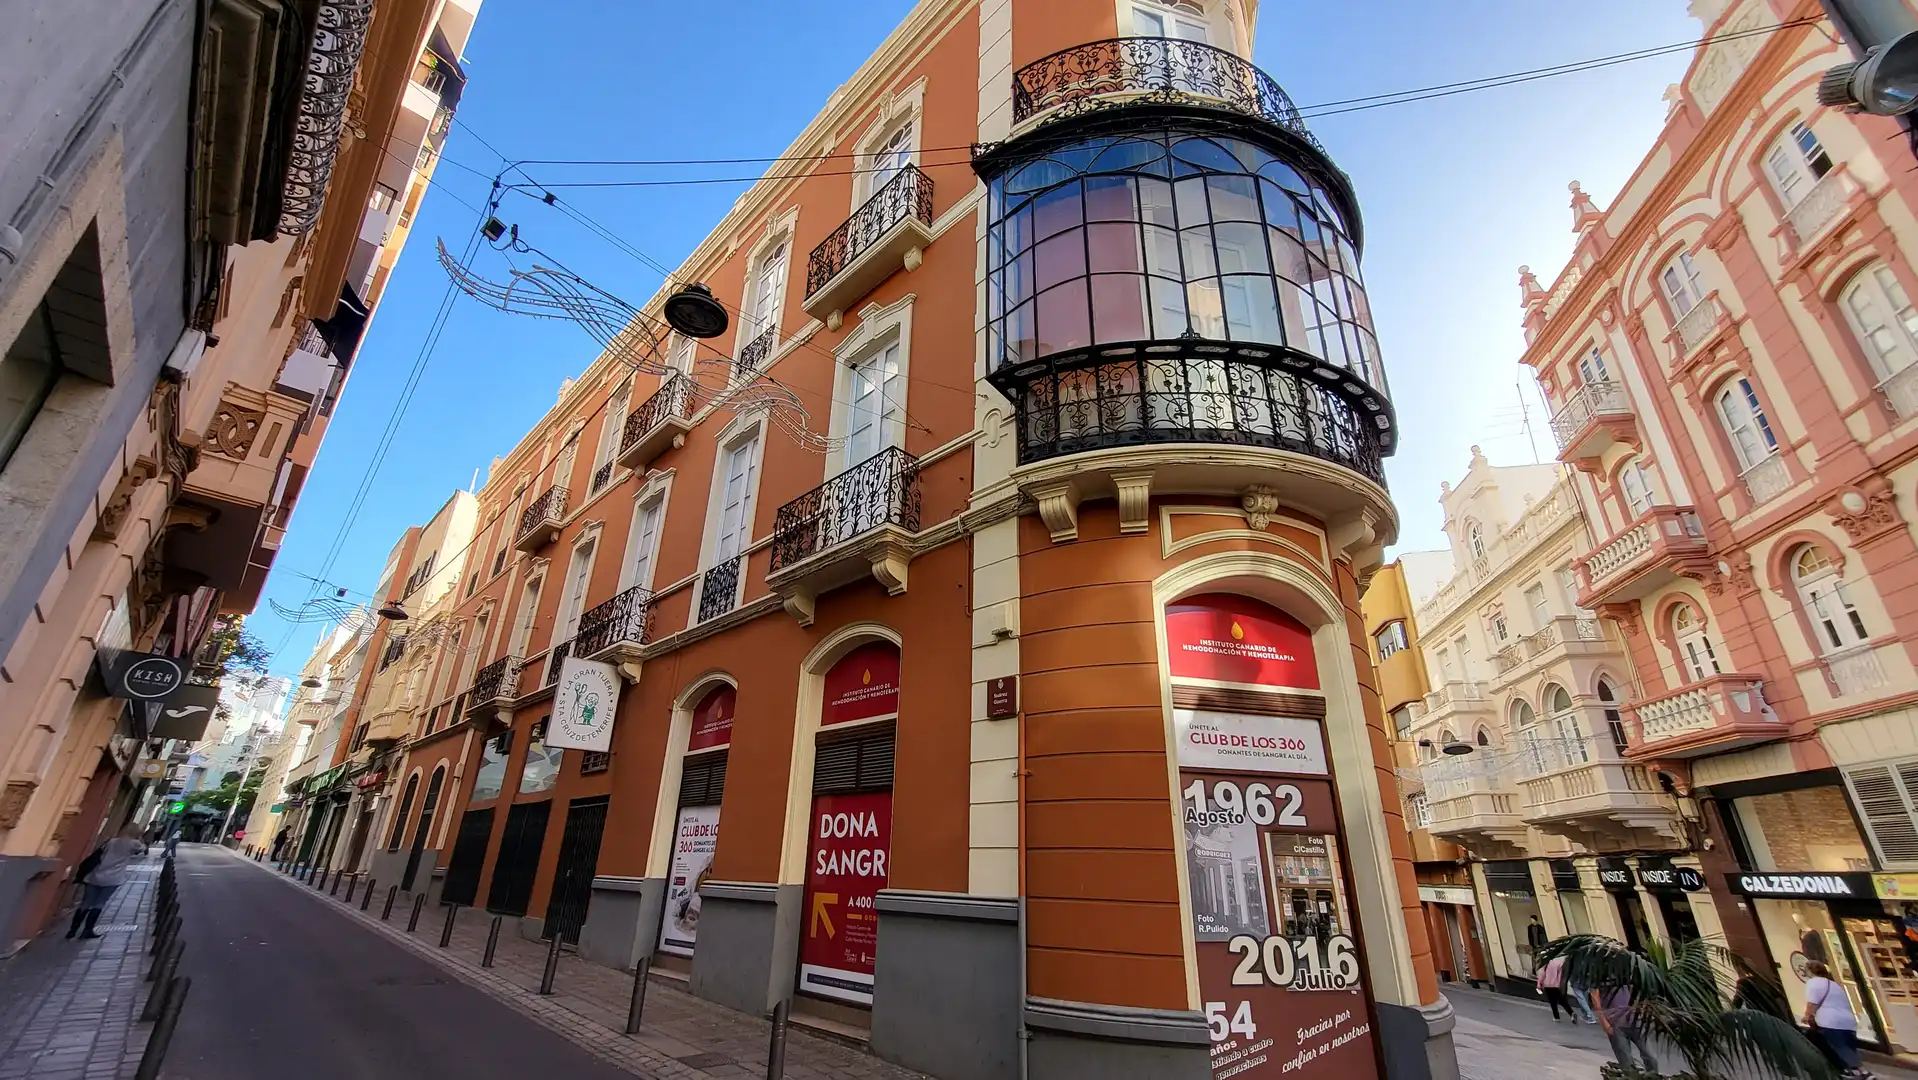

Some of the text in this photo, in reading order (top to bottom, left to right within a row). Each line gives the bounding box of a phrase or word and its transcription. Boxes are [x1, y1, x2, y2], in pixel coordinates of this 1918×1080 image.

[1182, 643, 1241, 656] HEMODONACIÓN
[1247, 651, 1295, 662] HEMOTERAPIA
[1199, 639, 1235, 649] INSTITUTO
[1235, 643, 1267, 652] CANARIO
[134, 669, 173, 683] KISH
[564, 669, 614, 697] LA GRAN TIJERA
[560, 719, 577, 739] CRUZ
[587, 707, 614, 740] TENERIFE
[1189, 722, 1210, 731] ÚNETE
[1190, 732, 1306, 751] CLUB DE LOS 300
[1217, 749, 1252, 757] DONANTES
[1261, 751, 1287, 759] SANGRE
[1183, 779, 1307, 827] 1962
[820, 811, 879, 839] DONA
[1185, 807, 1245, 827] Agosto
[681, 825, 700, 838] CLUB
[700, 824, 710, 837] DE
[678, 841, 692, 853] 300
[1308, 837, 1323, 845] Foto
[1293, 845, 1324, 854] C/Castillo
[816, 849, 886, 877] SANGR
[1600, 870, 1628, 883] INSIDE
[1641, 870, 1673, 883] INSIDE
[1680, 872, 1700, 886] IN
[1741, 876, 1851, 894] CALZEDONIA
[847, 896, 872, 909] A 400
[1197, 914, 1214, 923] Foto
[1198, 924, 1229, 933] R.Pulido
[1229, 936, 1359, 985] 2016
[1295, 969, 1346, 990] Julio
[1205, 1000, 1257, 1041] 54
[1297, 1009, 1351, 1046] Gracias por
[1210, 1040, 1238, 1056] años
[1282, 1022, 1370, 1073] confiar en nosotros
